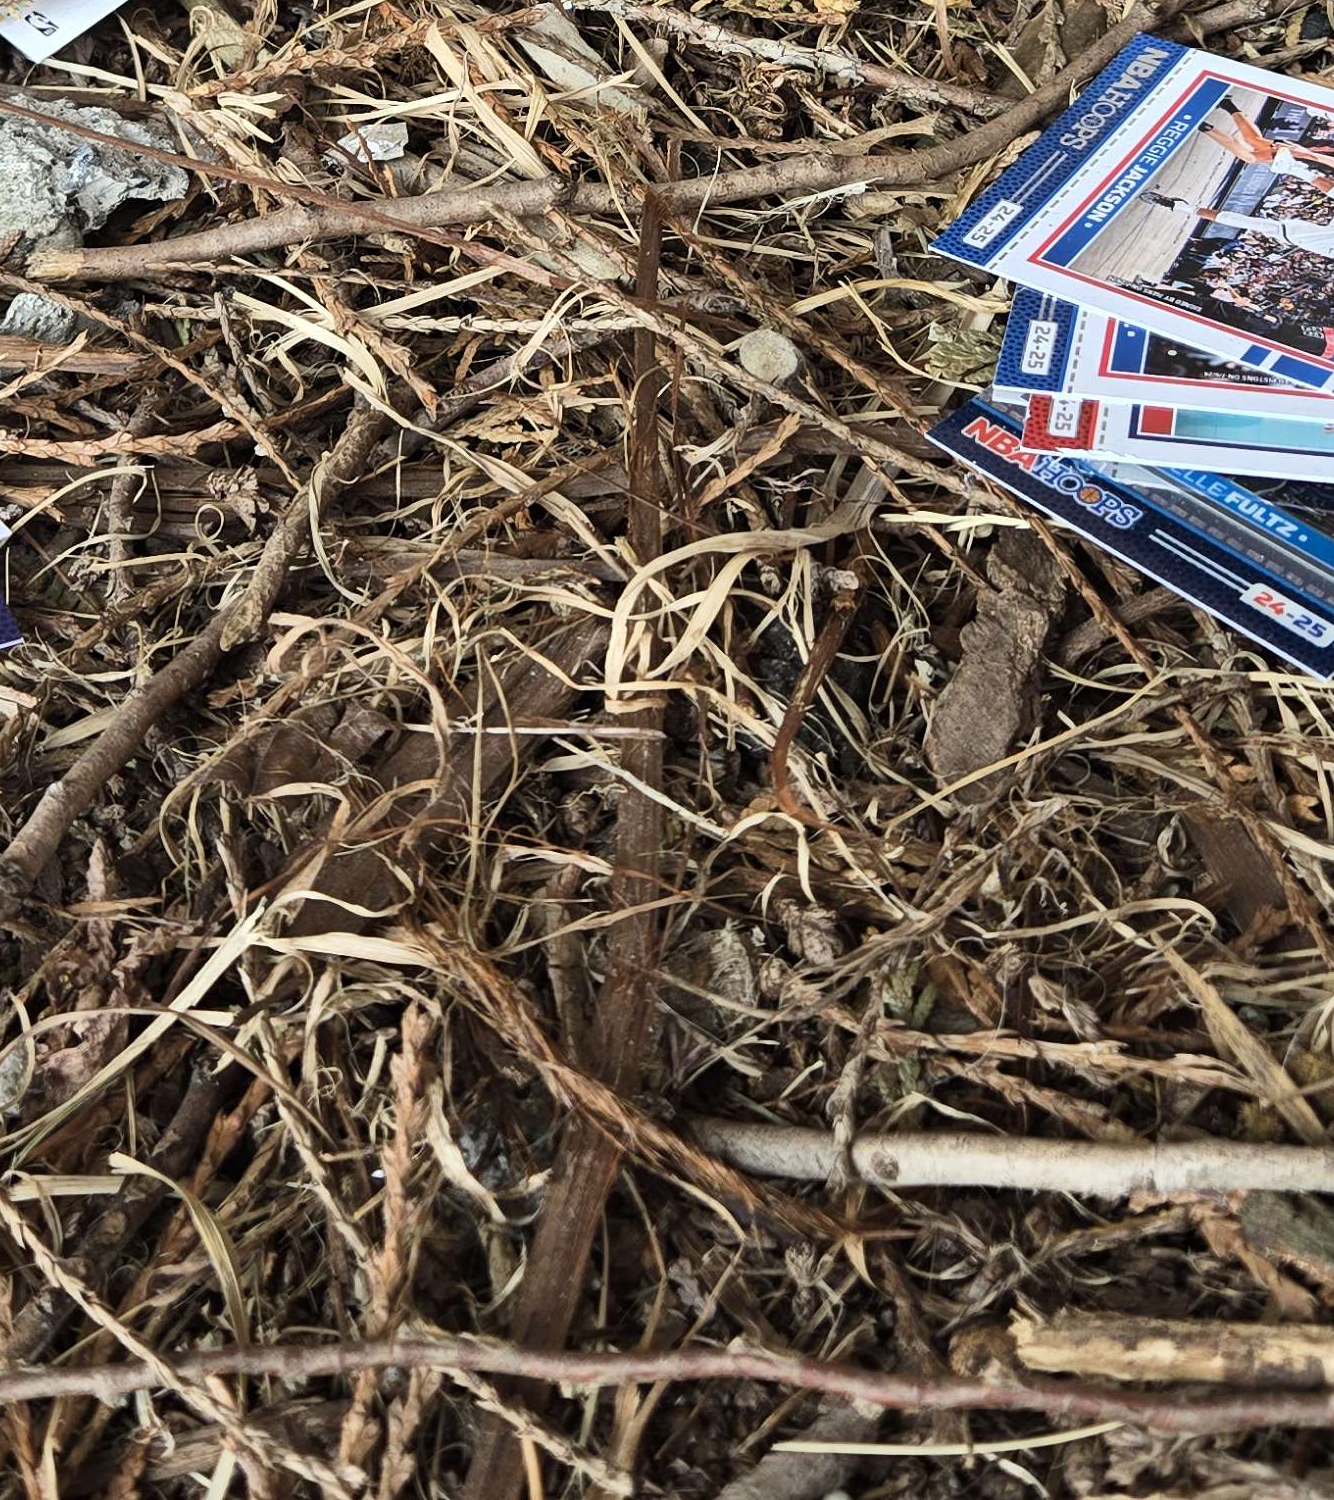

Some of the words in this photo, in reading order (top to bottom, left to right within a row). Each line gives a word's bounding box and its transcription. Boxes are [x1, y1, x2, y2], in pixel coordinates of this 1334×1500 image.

[1108, 44, 1169, 92] NBA
[1056, 84, 1133, 152] HOOPS
[1138, 118, 1188, 168] REGGIE
[1084, 161, 1147, 224] JACKSON
[967, 201, 1014, 247] 24-25
[1026, 324, 1051, 370] 24-25
[962, 414, 1038, 474] NBA
[1030, 453, 1144, 534] HOOPS
[1222, 488, 1299, 540] FULTZ
[1252, 590, 1327, 639] 24-25
